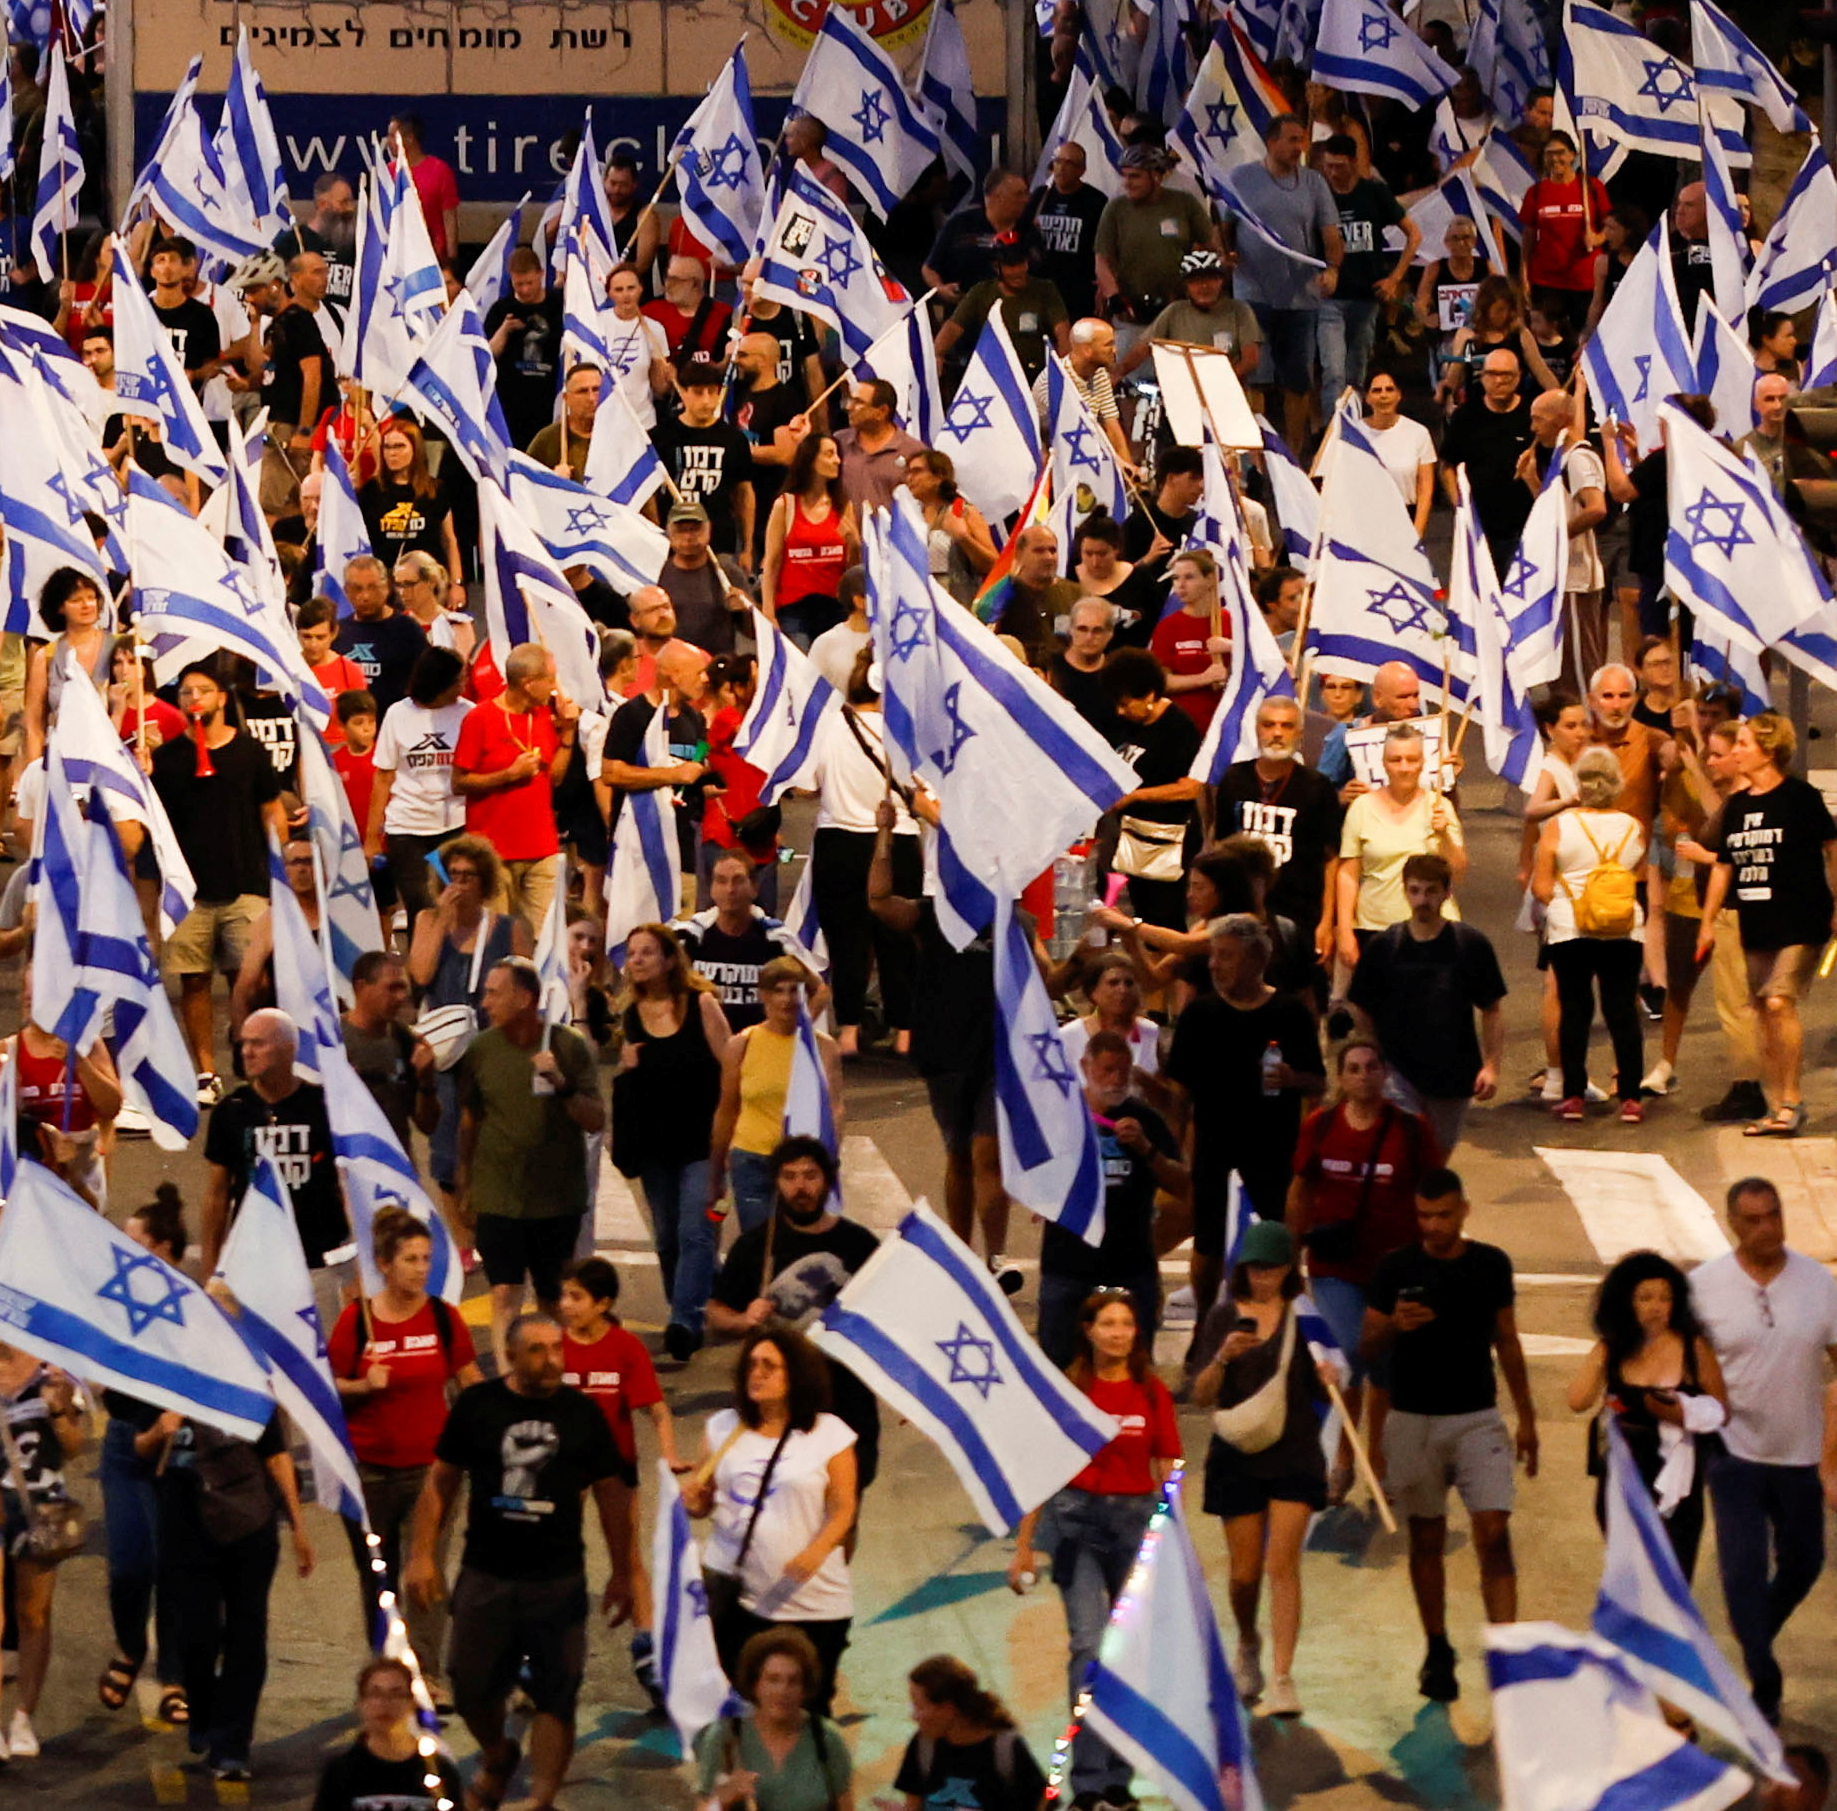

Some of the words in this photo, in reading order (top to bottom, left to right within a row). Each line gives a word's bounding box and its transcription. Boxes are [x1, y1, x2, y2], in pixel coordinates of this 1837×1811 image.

[220, 19, 365, 49] לצמיגים
[389, 27, 521, 49] מומחים
[550, 28, 631, 49] רשת
[682, 445, 726, 469] דמו
[681, 467, 723, 496] קרט
[245, 716, 294, 742] דמו
[264, 741, 295, 773] קר
[1241, 800, 1297, 836] דמו
[252, 1124, 311, 1160] דמו
[281, 1156, 312, 1192] קר
